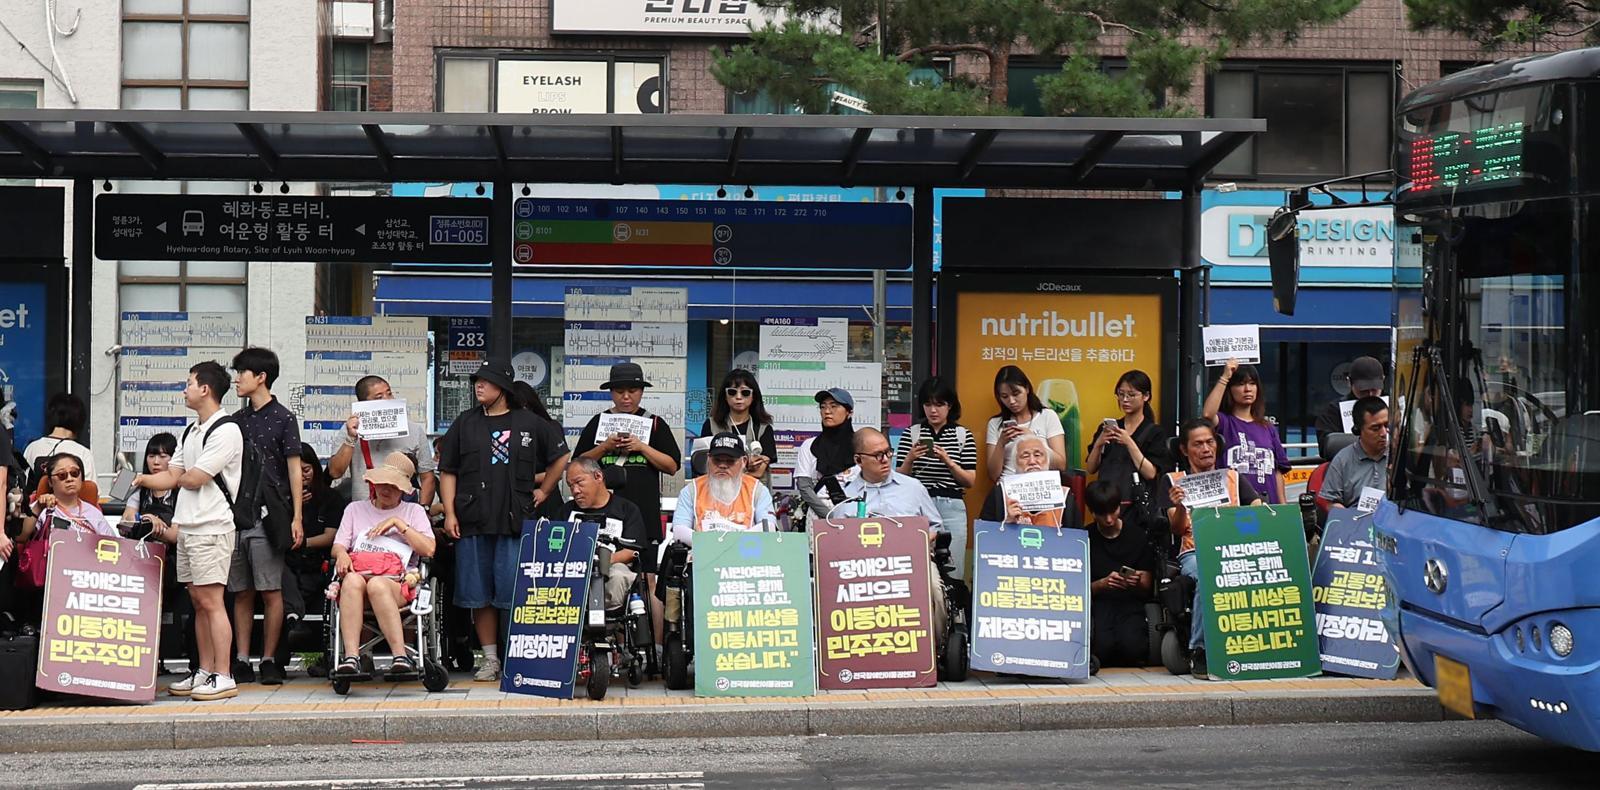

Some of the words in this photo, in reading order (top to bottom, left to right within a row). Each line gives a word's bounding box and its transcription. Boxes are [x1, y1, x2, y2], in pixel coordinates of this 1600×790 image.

[644, 16, 684, 24] PREMIUM
[523, 76, 582, 86] EYELASH
[537, 91, 568, 102] LIPS
[538, 205, 550, 213] 100
[557, 205, 569, 213] 102
[575, 205, 588, 213] 104
[615, 206, 628, 214] 107
[656, 207, 669, 215] 143
[676, 207, 688, 215] 150
[695, 207, 707, 215] 151
[714, 208, 727, 216] 160
[734, 208, 747, 216] 162
[753, 208, 766, 216] 171
[774, 208, 787, 216] 172
[794, 208, 807, 216] 272
[814, 209, 827, 217] 710
[112, 228, 143, 238] 성대입구
[219, 222, 268, 241] 여운형
[276, 222, 310, 241] 활동
[318, 223, 334, 241] 터
[434, 230, 484, 243] 01-005
[635, 228, 649, 236] N31
[1298, 219, 1394, 242] DESIGN
[166, 244, 220, 254] Hyehwa-dong
[223, 245, 251, 255] Rotary,
[254, 245, 269, 254] Site
[272, 246, 281, 254] of
[305, 246, 356, 256] Woon-hyung
[1300, 247, 1377, 256] RINTING
[1036, 283, 1081, 292] JCDecaux
[315, 316, 328, 324] N31
[981, 311, 1135, 337] nutribullet
[457, 332, 485, 347] 283
[981, 347, 1018, 361] 최적의
[1022, 347, 1082, 362] 뉴트리션을
[1086, 348, 1135, 362] 추출하다
[517, 365, 537, 373] 아크릴
[126, 418, 139, 426] 107
[980, 554, 1018, 569] "국회
[1022, 556, 1050, 571] 1호
[1052, 557, 1083, 573] 법안
[1324, 545, 1360, 563] "국회
[1362, 551, 1377, 565] 1
[546, 561, 564, 578] 1호
[565, 561, 587, 578] 법안
[829, 556, 913, 580] "장애인도
[1220, 559, 1257, 574] 저희는
[1258, 556, 1284, 571] 함께
[63, 569, 144, 593] "장애인도
[718, 581, 756, 594] 저희는
[757, 580, 783, 592] 함께
[997, 575, 1066, 594] 교통약자
[1215, 572, 1264, 588] 이동하고
[1265, 569, 1292, 583] 싶고,
[1330, 570, 1386, 591] 교통약
[526, 587, 571, 605] 교통약자
[711, 593, 761, 606] 이동하고
[763, 592, 791, 605] 싶고,
[836, 579, 911, 603] 시민으로
[1213, 590, 1248, 612] 함께
[1251, 586, 1301, 608] 세상을
[66, 592, 140, 615] 시민으로
[980, 591, 1083, 612] 이동권보장법
[514, 606, 580, 625] 이동권보장법
[707, 610, 743, 629] 함께
[747, 608, 798, 627] 세상을
[830, 604, 921, 632] 이동하는
[1218, 608, 1303, 633] 이동시키고
[57, 614, 147, 643] 이동하는
[978, 616, 1082, 642] 제정하라"
[508, 634, 575, 659] 제정하라"
[710, 629, 798, 649] 이동시키고
[827, 630, 927, 660] 민주주의"
[1225, 629, 1304, 655] 싶습니다."
[50, 639, 151, 667] 민주주의"
[715, 650, 798, 672] 싶습니다."
